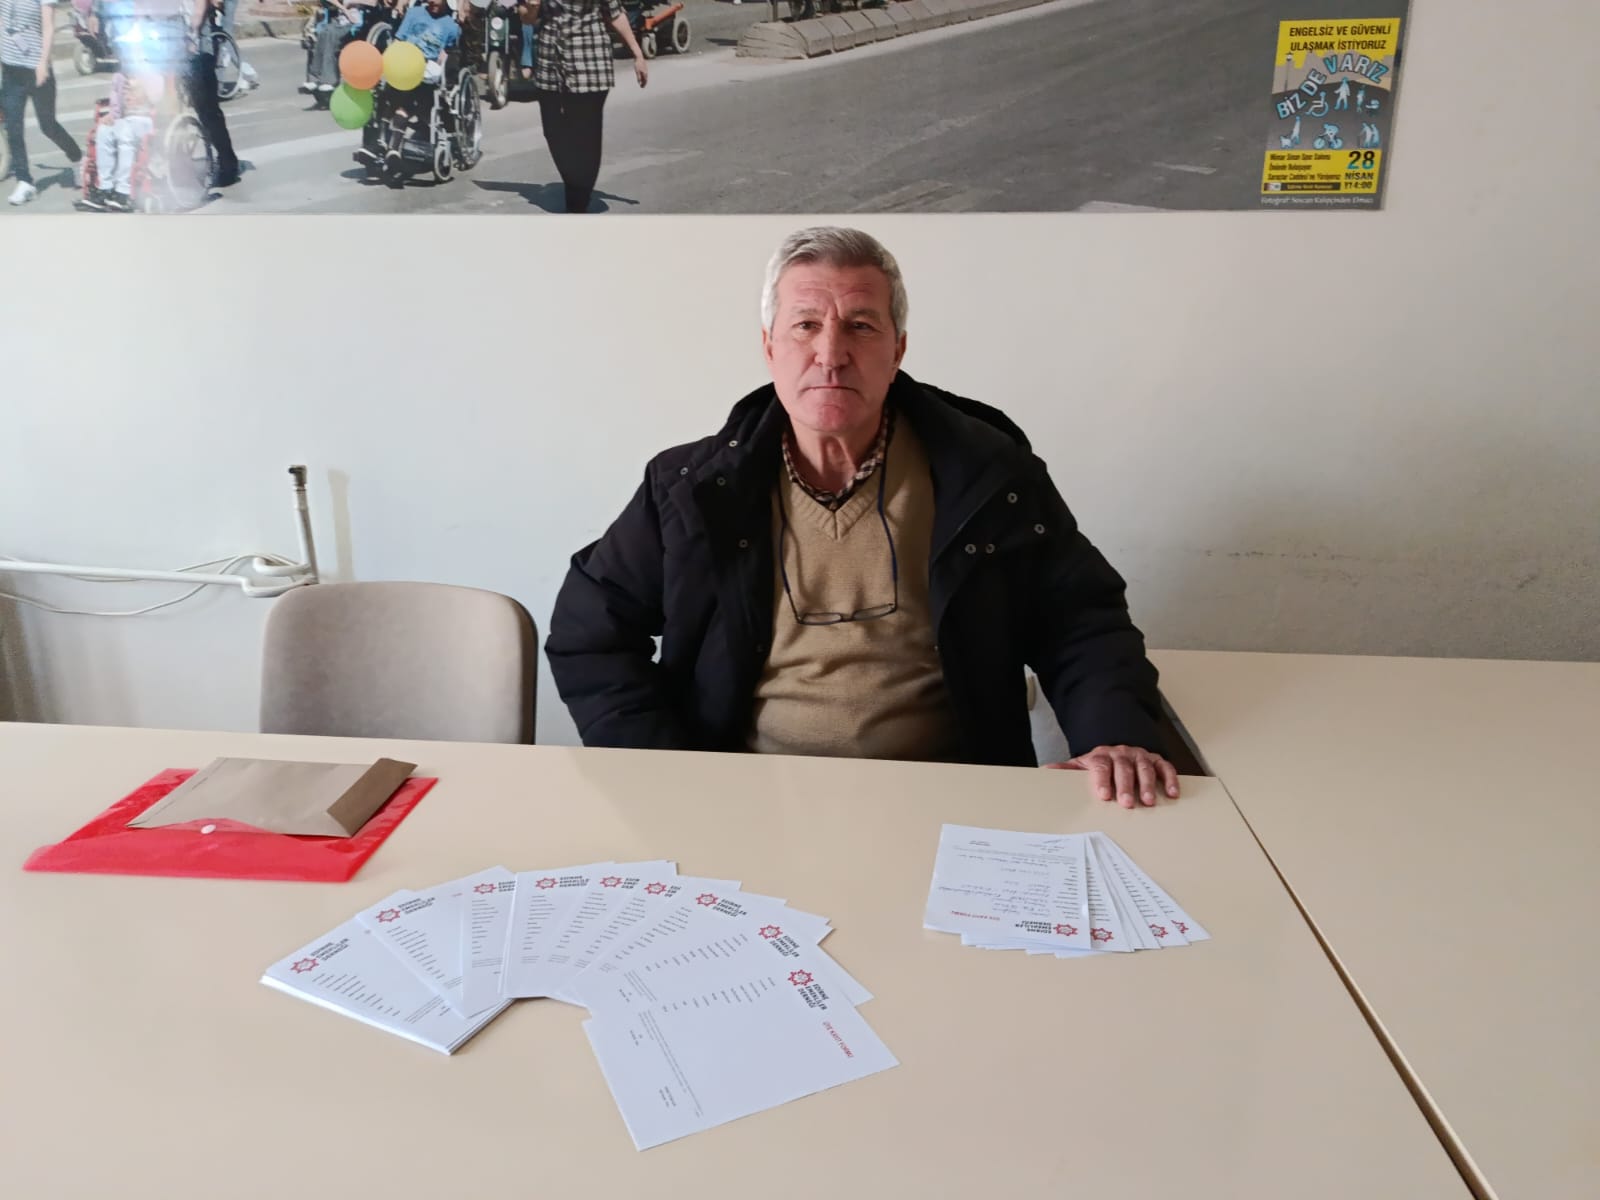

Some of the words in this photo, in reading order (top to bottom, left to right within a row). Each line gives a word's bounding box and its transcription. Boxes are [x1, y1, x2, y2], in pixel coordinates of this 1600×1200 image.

[1289, 24, 1334, 37] ENGELSİZ
[1336, 26, 1348, 35] VE
[1350, 24, 1391, 35] GÜVENLİ
[1290, 41, 1335, 53] ULAŞMAK
[1337, 40, 1386, 50] İSTİYORUZ
[1276, 93, 1306, 119] BİZ
[1300, 68, 1327, 97] DE
[1323, 53, 1389, 84] VARIZ
[1347, 150, 1375, 170] 28
[1344, 171, 1374, 180] NİSAN
